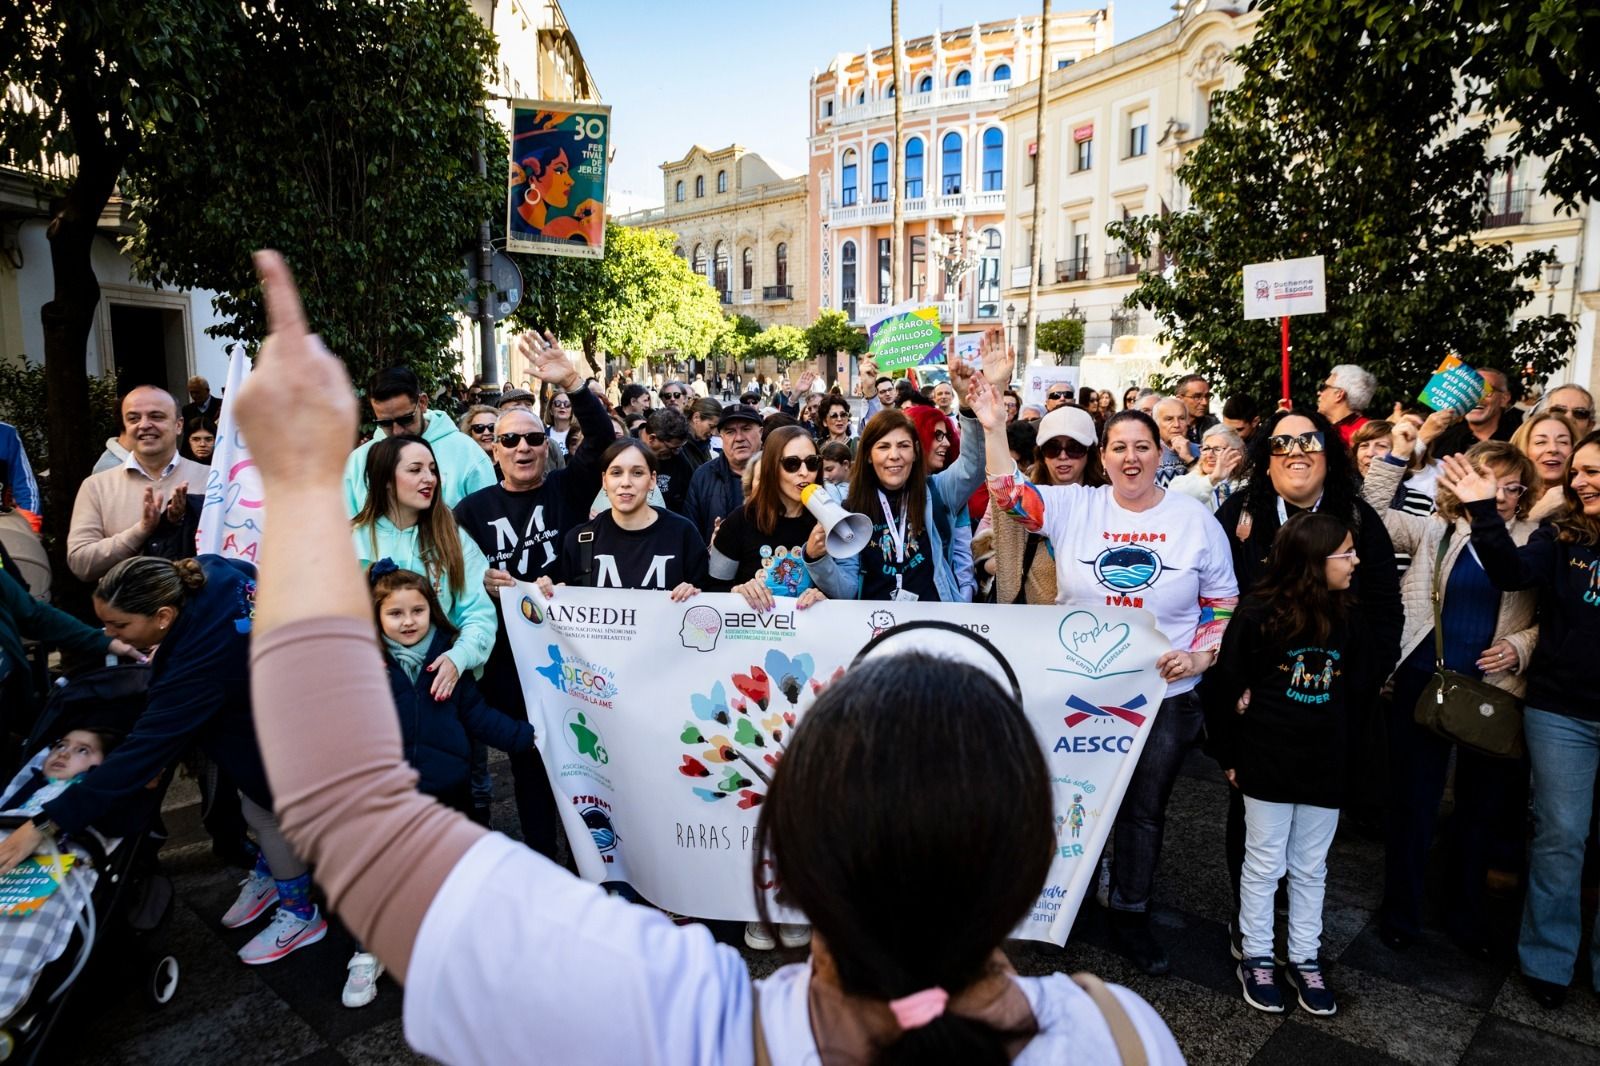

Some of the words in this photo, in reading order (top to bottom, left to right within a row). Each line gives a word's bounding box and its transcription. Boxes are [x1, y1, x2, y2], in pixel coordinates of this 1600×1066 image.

[574, 115, 604, 141] 30
[588, 143, 603, 151] FES
[582, 150, 602, 159] TIVAL
[577, 166, 602, 175] JEREZ
[591, 159, 602, 168] DE
[1274, 280, 1313, 288] Duchenne
[899, 319, 923, 330] RARO
[874, 329, 933, 347] MARAVILLOSO
[880, 346, 899, 355] cada
[901, 341, 935, 353] persona
[1105, 595, 1143, 609] IVAN
[546, 604, 637, 626] ANSEDH
[724, 611, 796, 630] aevel
[1286, 688, 1330, 704] UNIPER
[598, 699, 613, 709] AME
[1053, 735, 1134, 754] AESCO
[676, 823, 731, 850] RARAS
[742, 826, 761, 851] PE
[0, 886, 31, 894] dad,
